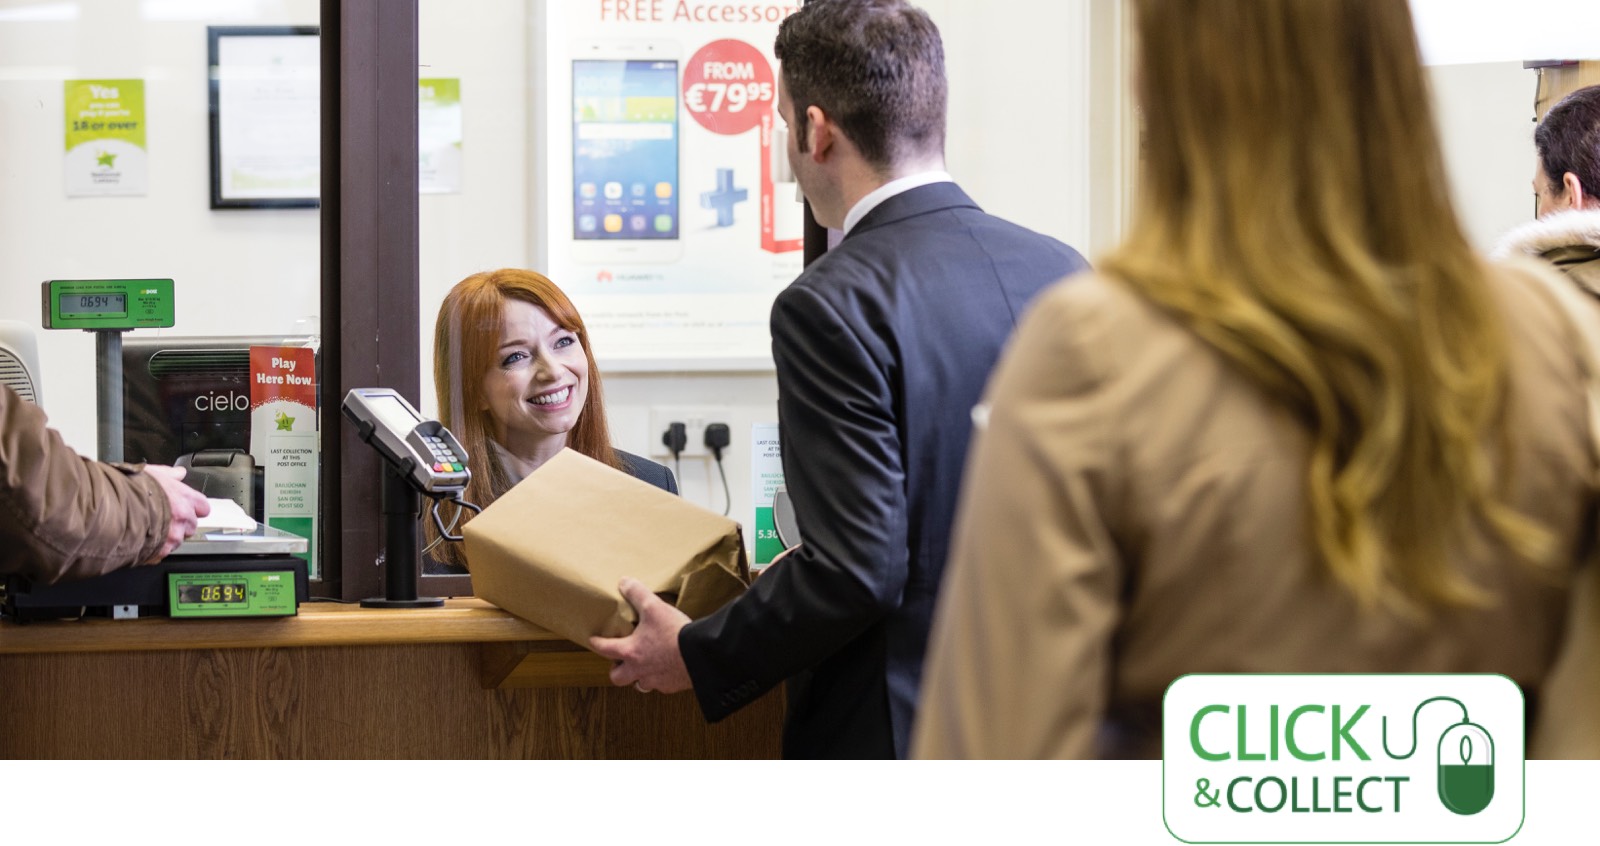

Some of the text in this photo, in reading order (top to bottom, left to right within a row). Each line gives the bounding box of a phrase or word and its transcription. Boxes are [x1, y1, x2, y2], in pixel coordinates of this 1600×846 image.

[600, 0, 663, 21] FREE
[703, 61, 755, 80] FROM
[89, 85, 119, 99] Yes
[73, 121, 88, 131] 18
[108, 122, 138, 130] over
[271, 357, 297, 371] Play
[256, 373, 312, 386] Here Now
[194, 390, 250, 412] cielo
